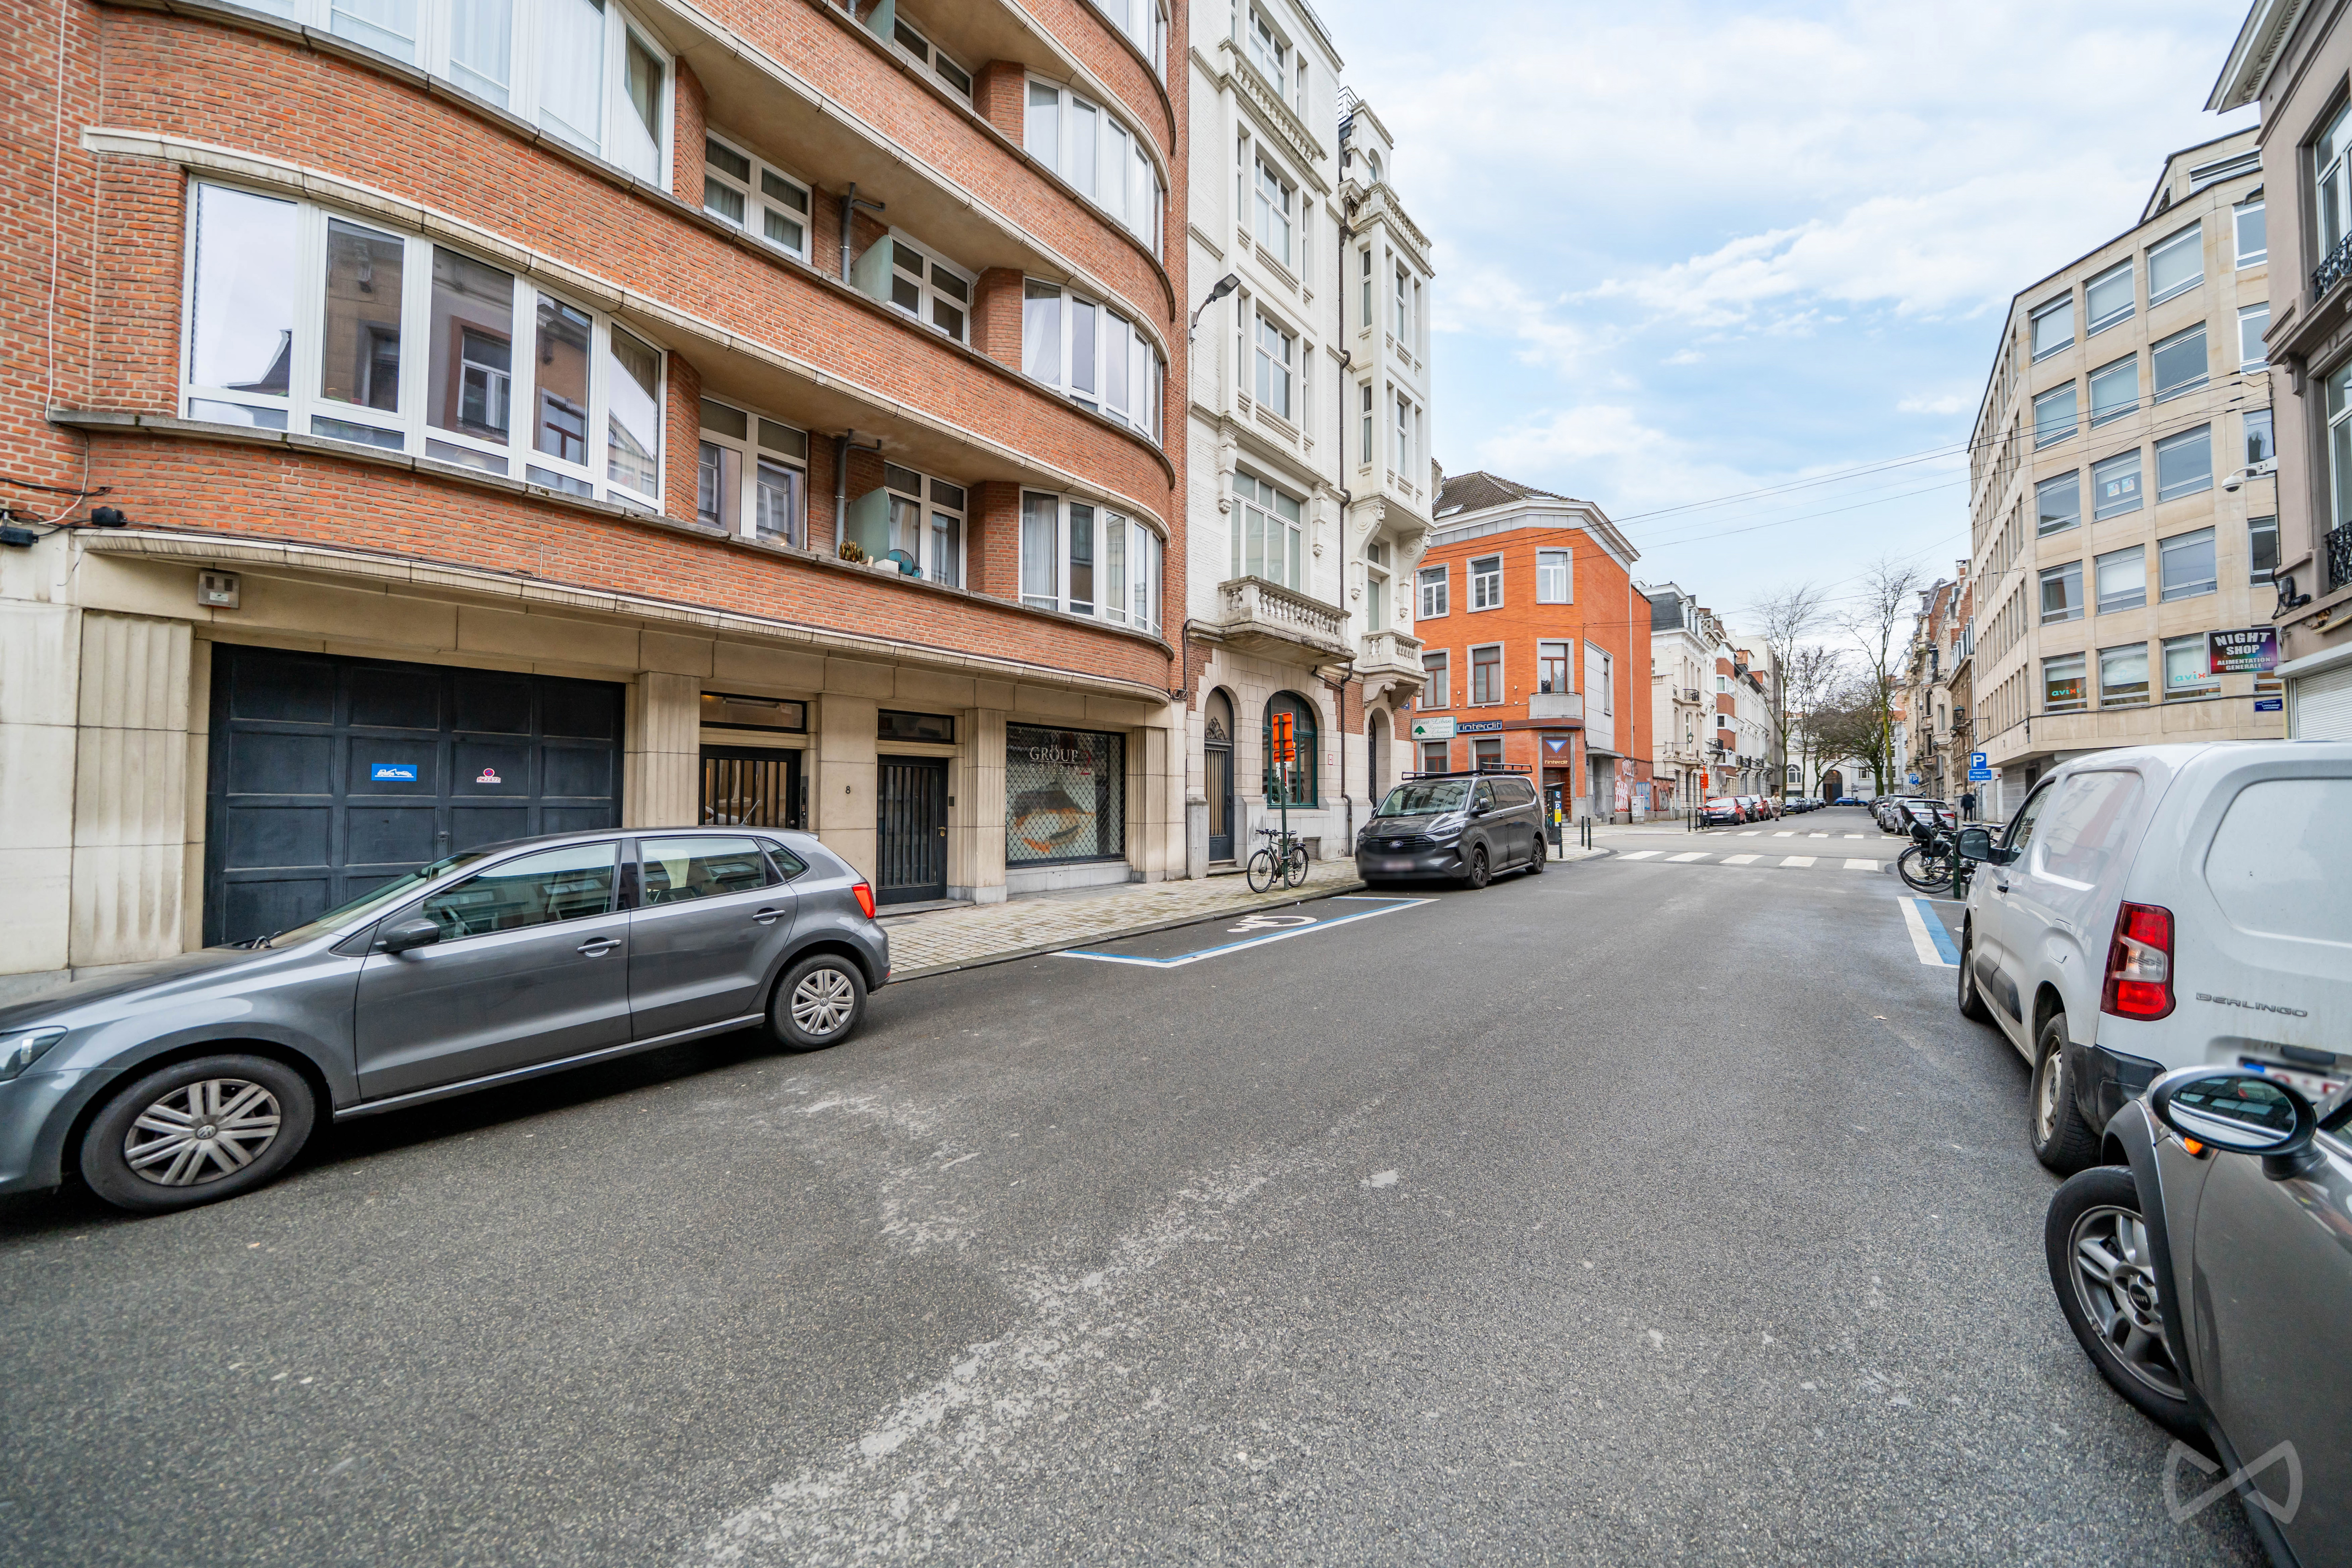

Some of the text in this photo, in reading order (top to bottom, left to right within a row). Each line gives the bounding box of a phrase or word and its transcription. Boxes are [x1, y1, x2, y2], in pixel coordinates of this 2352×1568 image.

[2214, 632, 2271, 646] NIGHT
[2226, 645, 2260, 655] SHOP
[2217, 657, 2271, 665] ALIMENTATION
[2175, 671, 2210, 681] avix
[1029, 746, 1078, 762] GROUP
[1080, 750, 1091, 775] 2
[1973, 755, 1984, 767] P
[845, 786, 851, 794] 8
[2196, 992, 2307, 1017] BERLINGO
[2132, 1292, 2148, 1303] MINI
